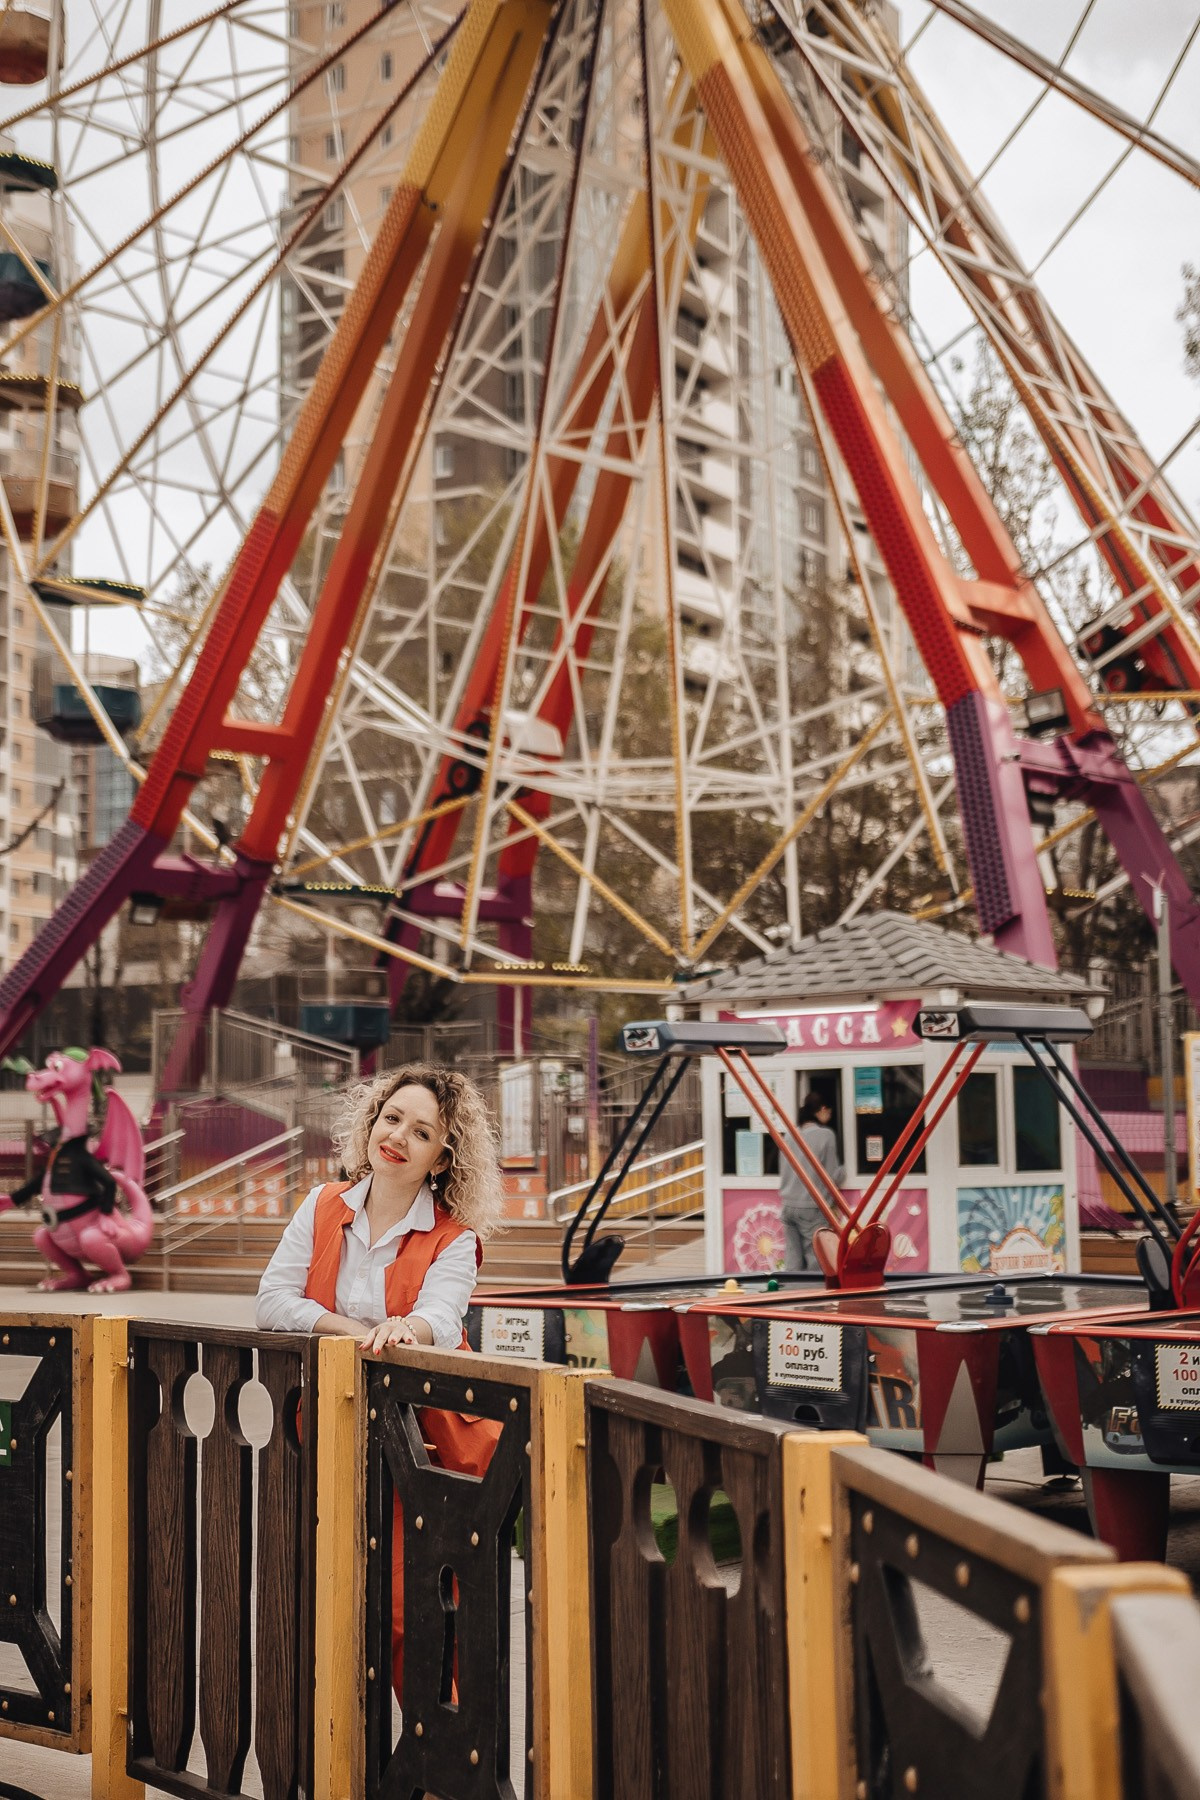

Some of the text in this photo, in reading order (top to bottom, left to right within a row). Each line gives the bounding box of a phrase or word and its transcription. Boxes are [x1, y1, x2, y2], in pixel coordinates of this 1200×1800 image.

[757, 1014, 881, 1047] АССА
[495, 1313, 503, 1325] 2
[491, 1328, 533, 1342] 100 руб.
[785, 1328, 793, 1340] 2
[495, 1344, 526, 1353] оплата
[779, 1344, 828, 1361] 100 руб.
[1180, 1352, 1189, 1365] 2
[785, 1362, 819, 1372] оплата
[1173, 1369, 1198, 1381] 100
